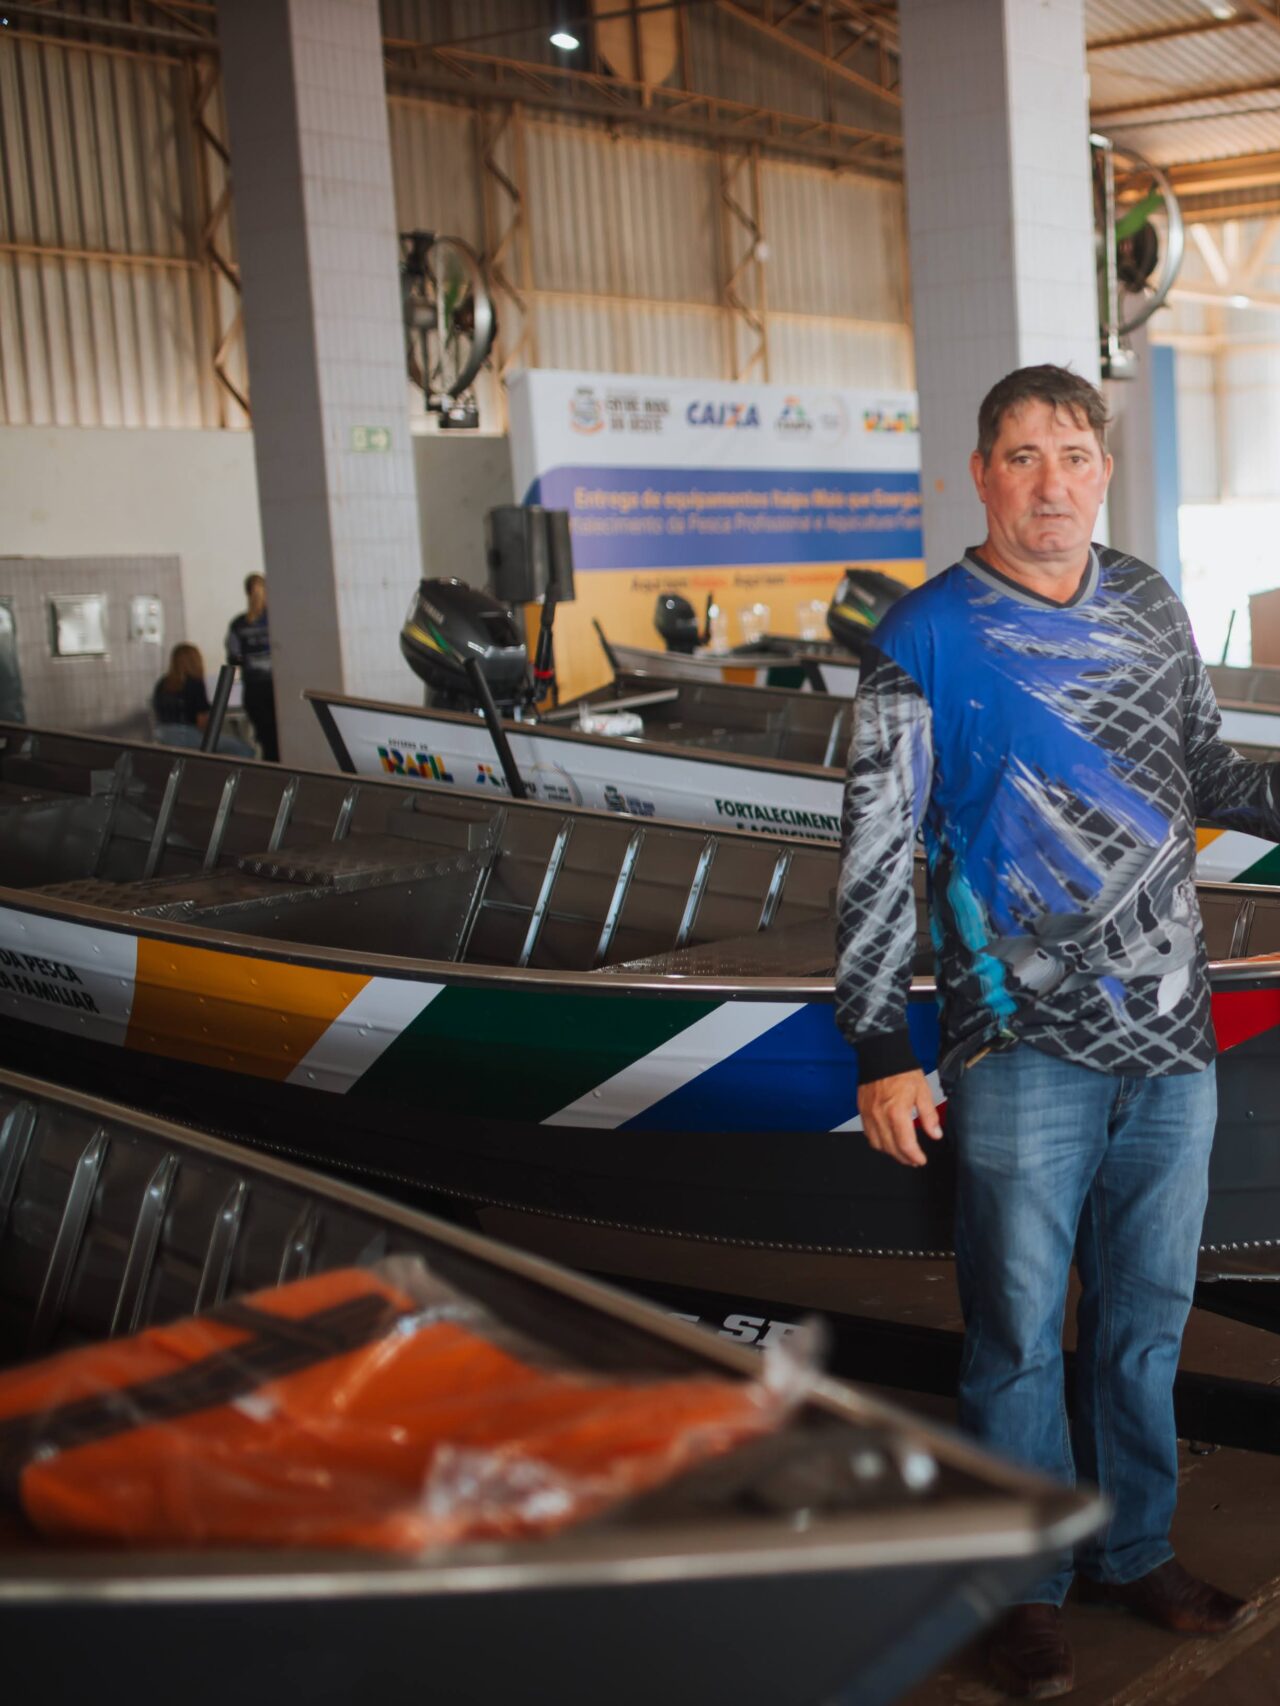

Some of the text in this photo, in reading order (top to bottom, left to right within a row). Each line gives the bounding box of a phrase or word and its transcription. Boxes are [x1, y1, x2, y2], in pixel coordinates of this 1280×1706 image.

[687, 400, 760, 428] CAIXA
[574, 487, 639, 513] Entrega
[665, 489, 768, 512] equipamentos
[377, 745, 455, 783] BRASIL
[714, 798, 840, 832] FORTALECIMENT
[21, 953, 84, 985] PESCA
[12, 974, 100, 1014] FAMILIAR
